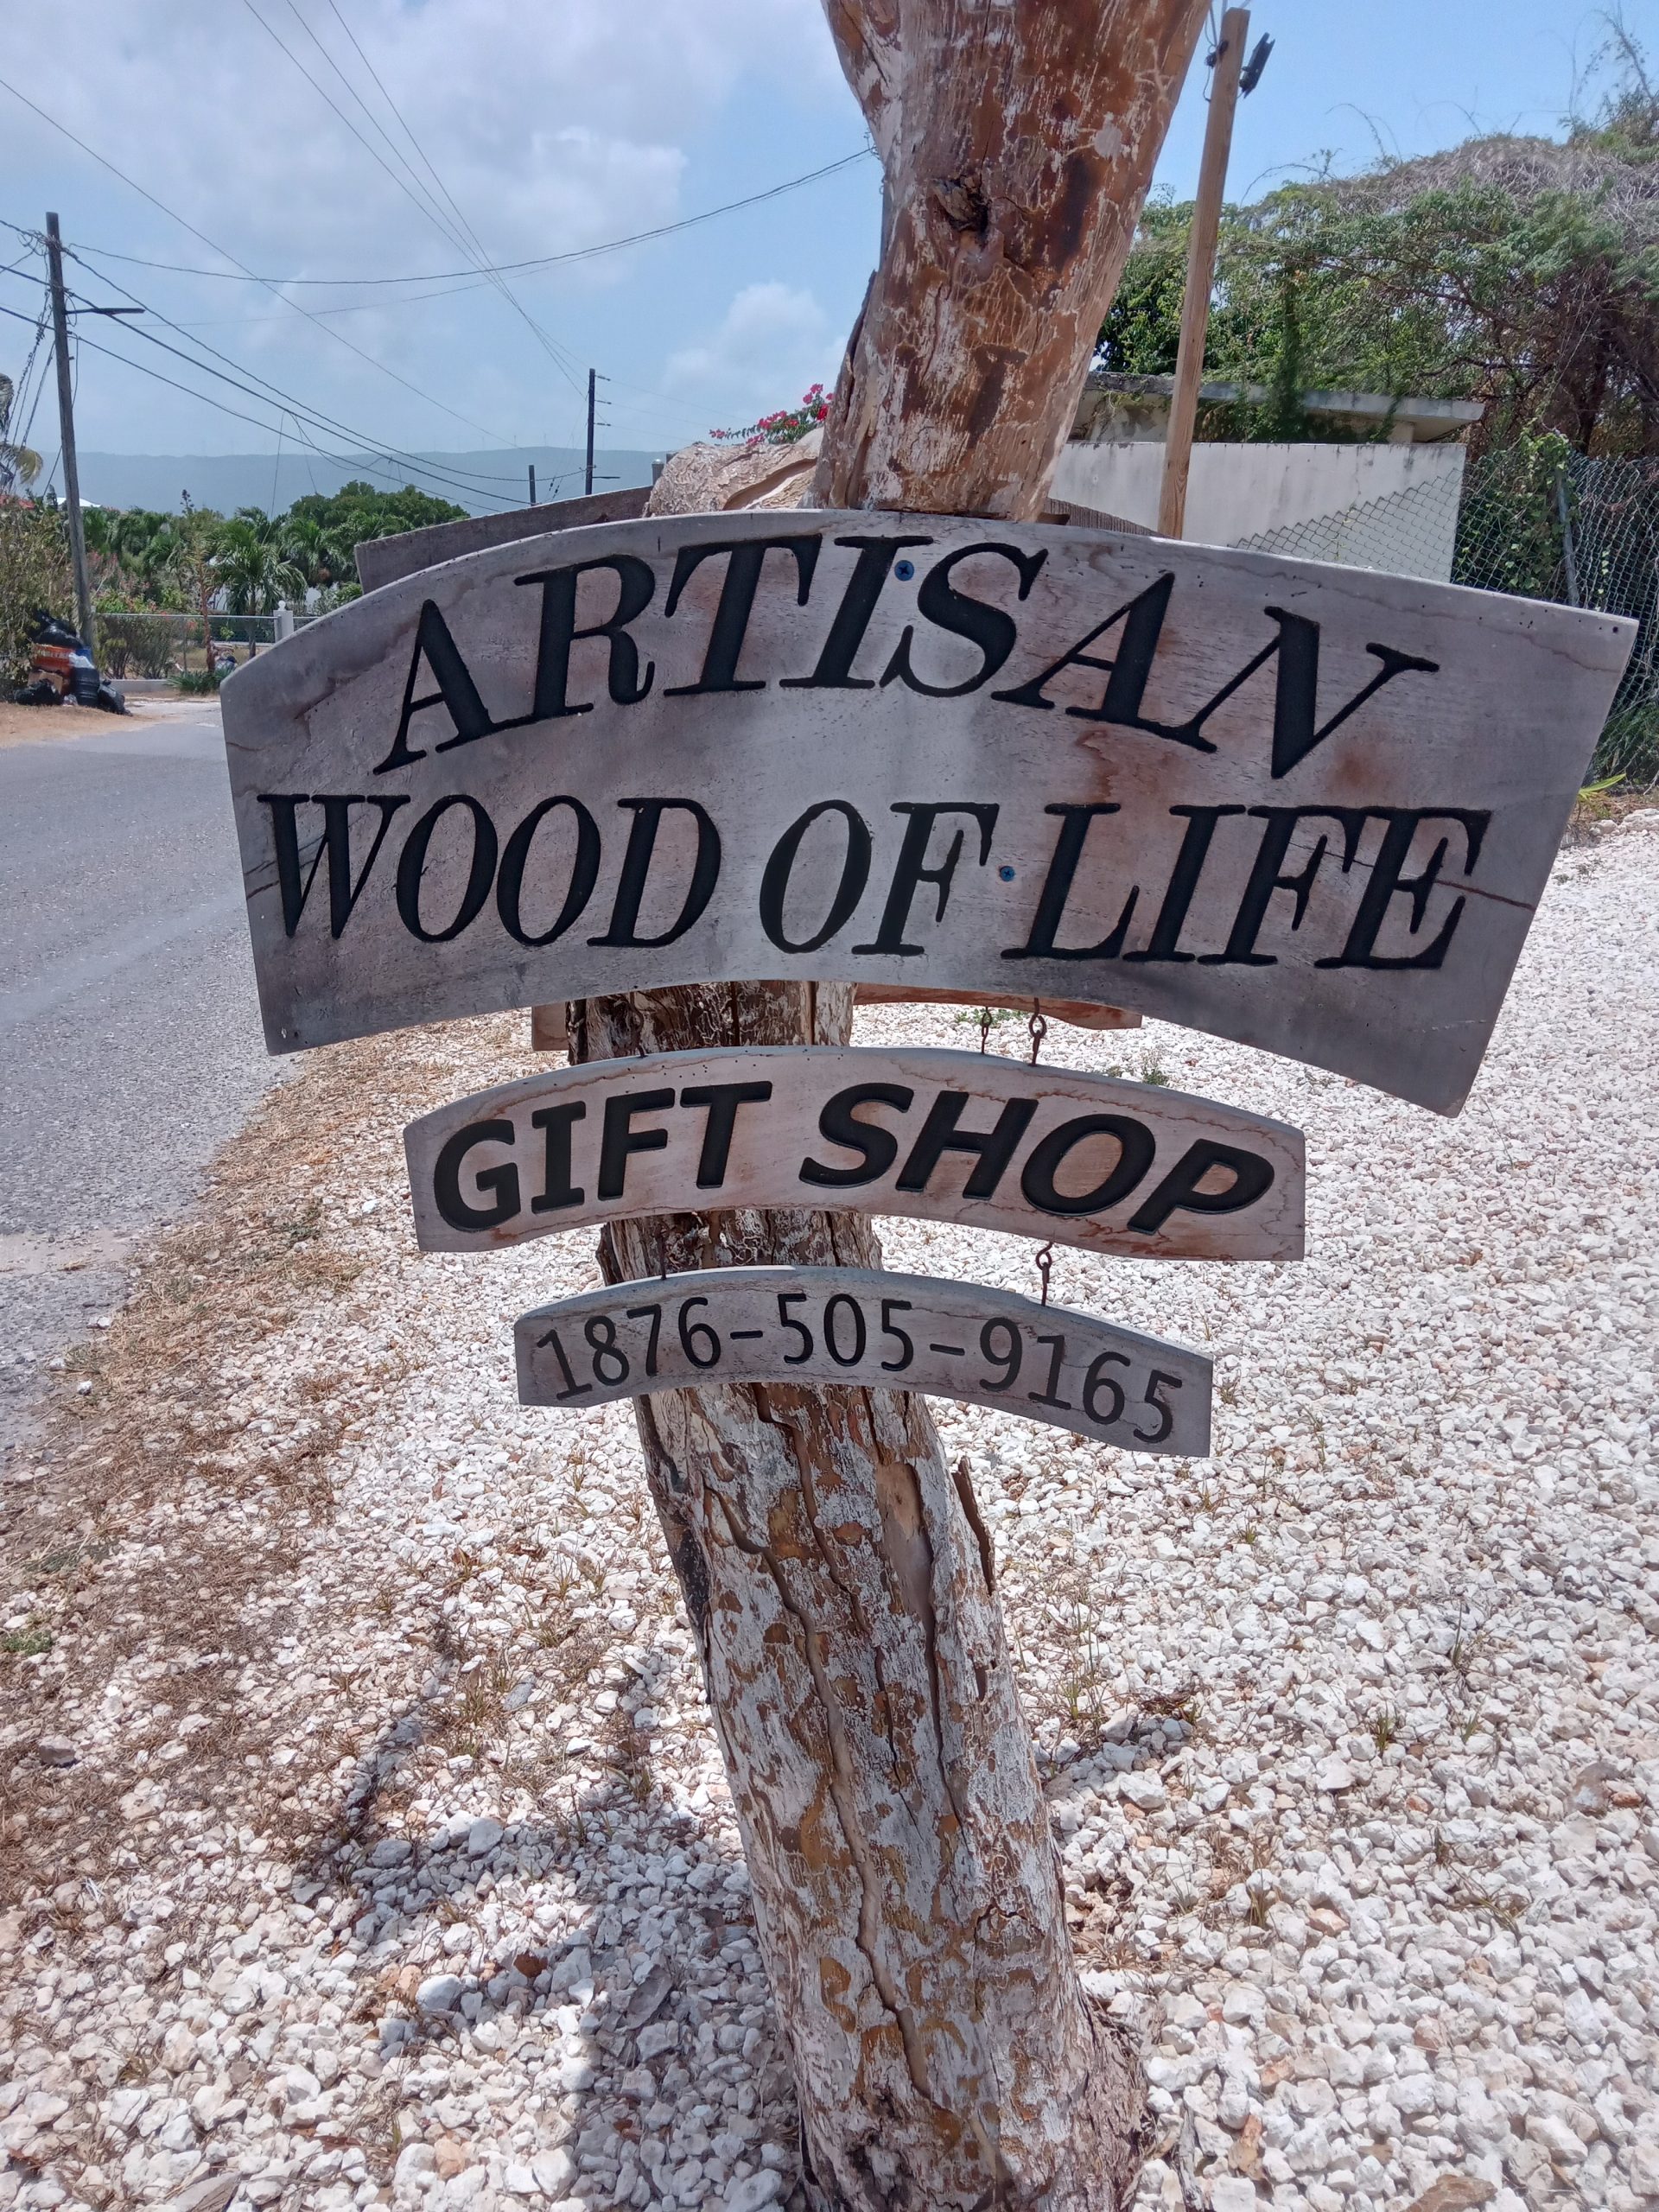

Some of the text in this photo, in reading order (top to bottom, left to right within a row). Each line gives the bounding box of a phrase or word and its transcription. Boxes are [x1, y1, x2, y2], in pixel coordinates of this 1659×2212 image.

[373, 534, 1439, 779] ARTISAN
[257, 792, 1492, 970] WOOD OF LIFE
[433, 1080, 1274, 1235] GIFT SHOP
[537, 1293, 1182, 1443] 1876-505-9165
